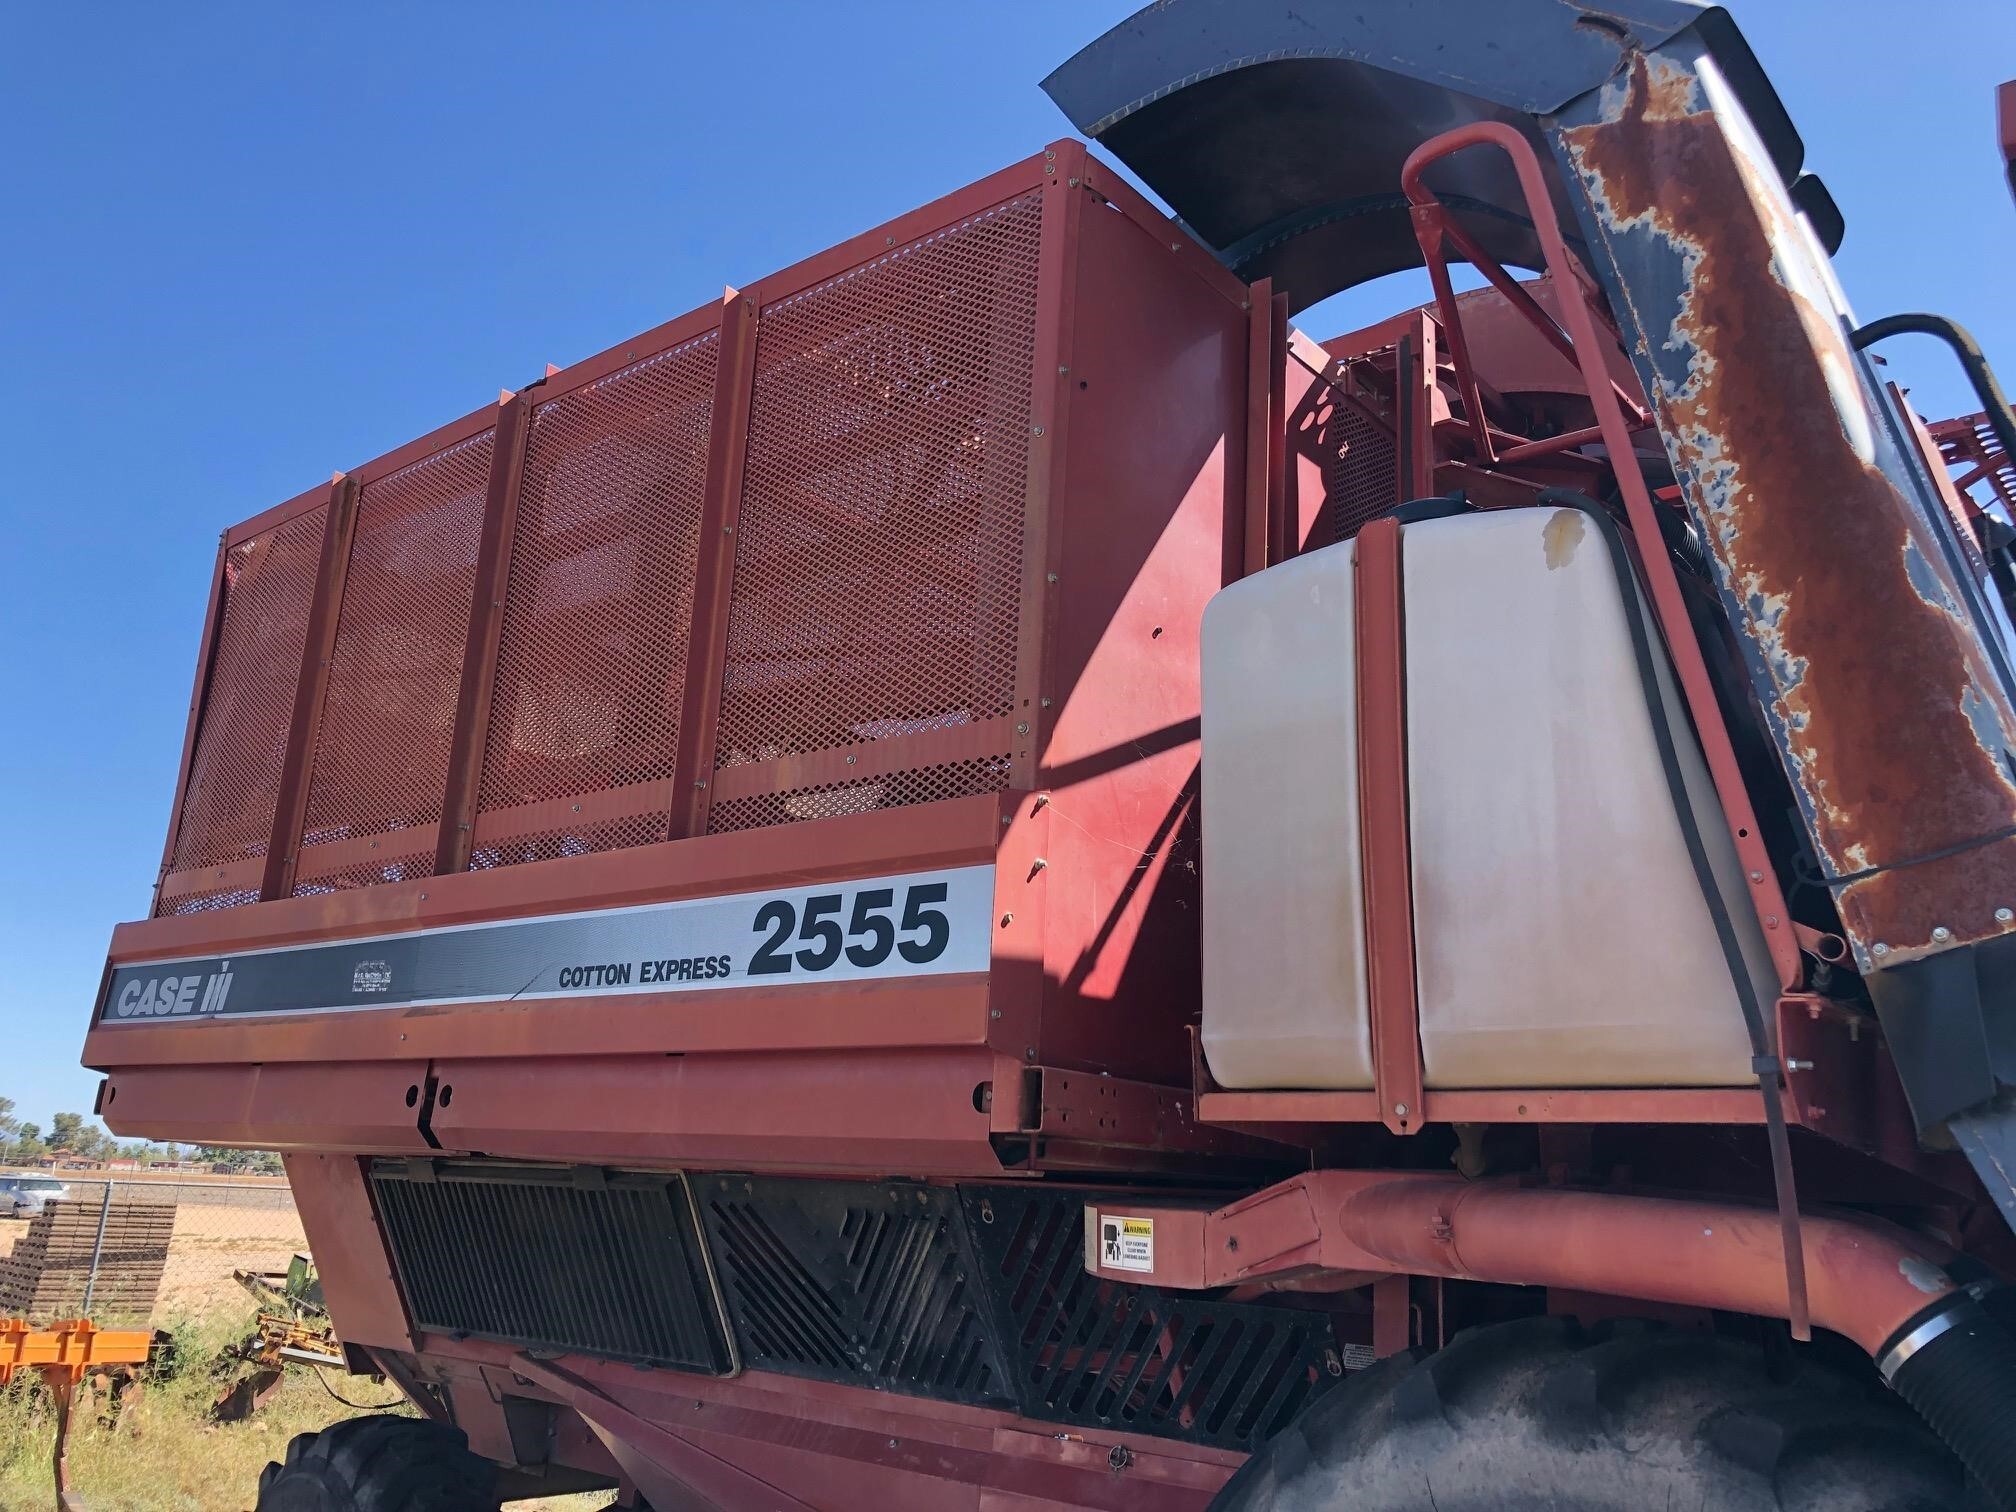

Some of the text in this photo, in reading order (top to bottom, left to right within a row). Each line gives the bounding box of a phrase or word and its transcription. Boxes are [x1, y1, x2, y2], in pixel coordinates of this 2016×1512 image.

[747, 882, 950, 976] 2555
[559, 955, 731, 988] COTTON EXPRESS
[118, 976, 201, 1017] CASE
[1129, 1225, 1151, 1235] WARNING
